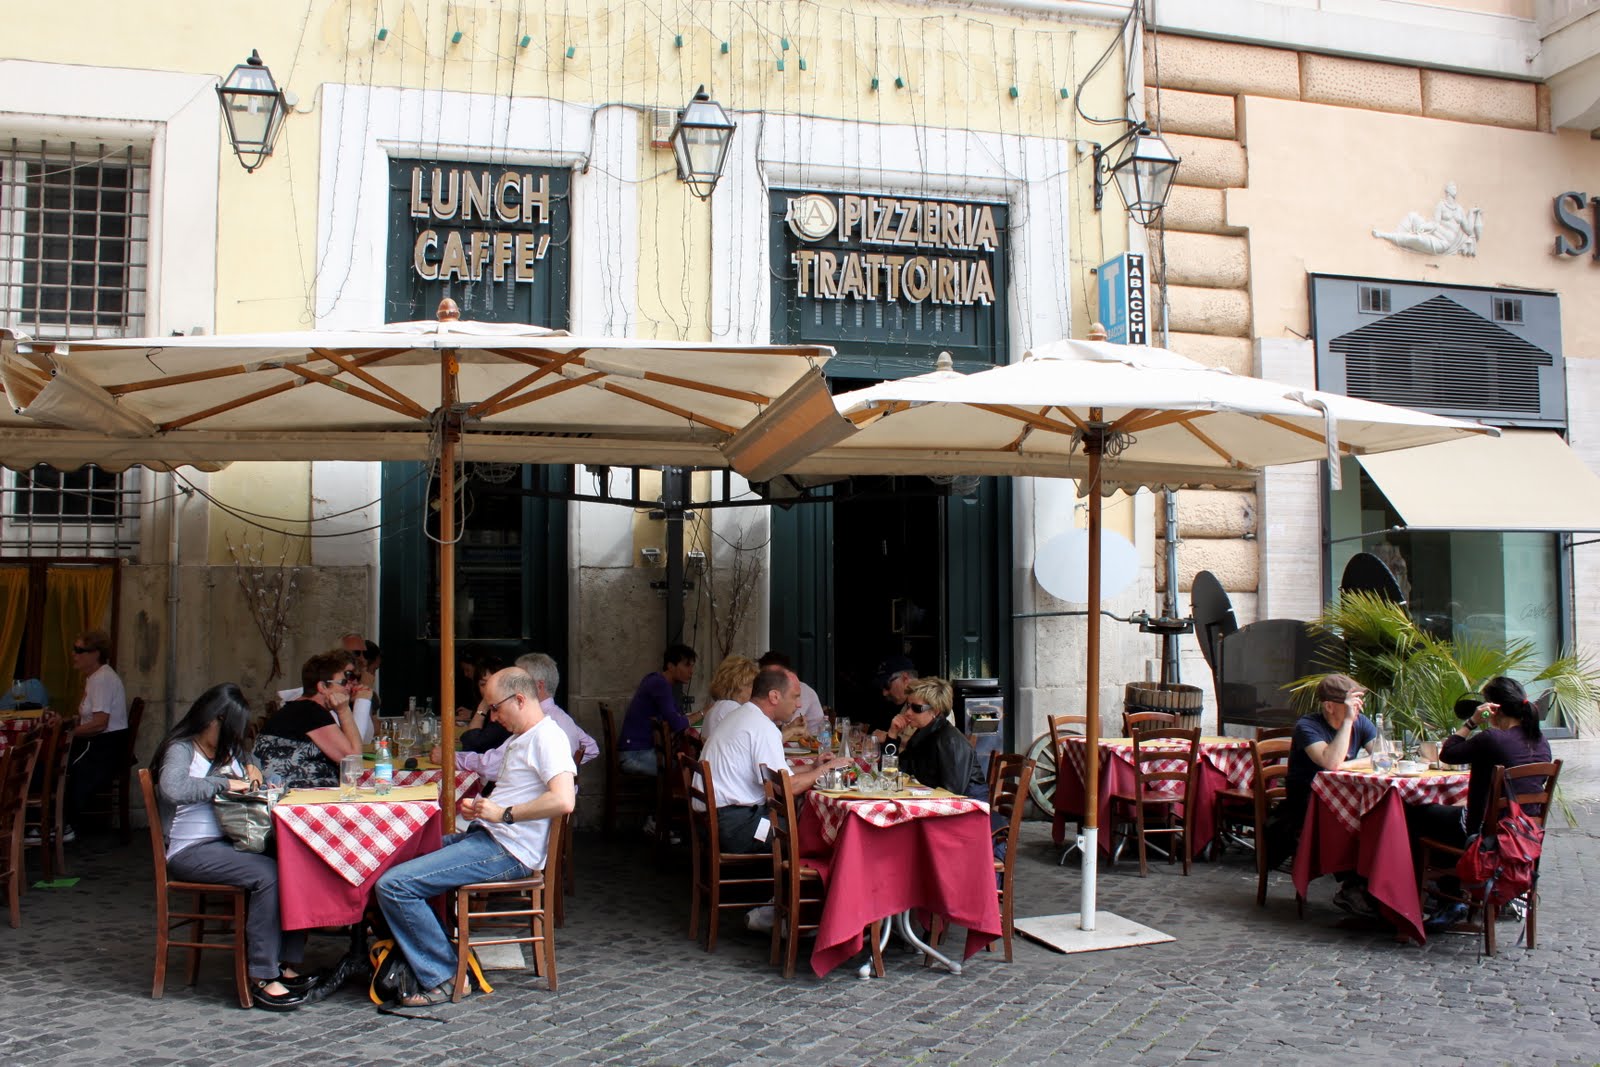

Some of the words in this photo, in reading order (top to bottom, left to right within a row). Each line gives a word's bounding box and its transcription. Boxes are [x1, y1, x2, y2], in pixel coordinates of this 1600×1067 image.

[411, 167, 550, 223] LUNCH
[838, 196, 998, 251] PIZZERIA
[1553, 191, 1600, 262] S
[414, 230, 550, 282] CAFFE'
[791, 250, 996, 306] TRATTORIA
[1103, 262, 1120, 326] T
[1129, 256, 1143, 343] TABACCHI
